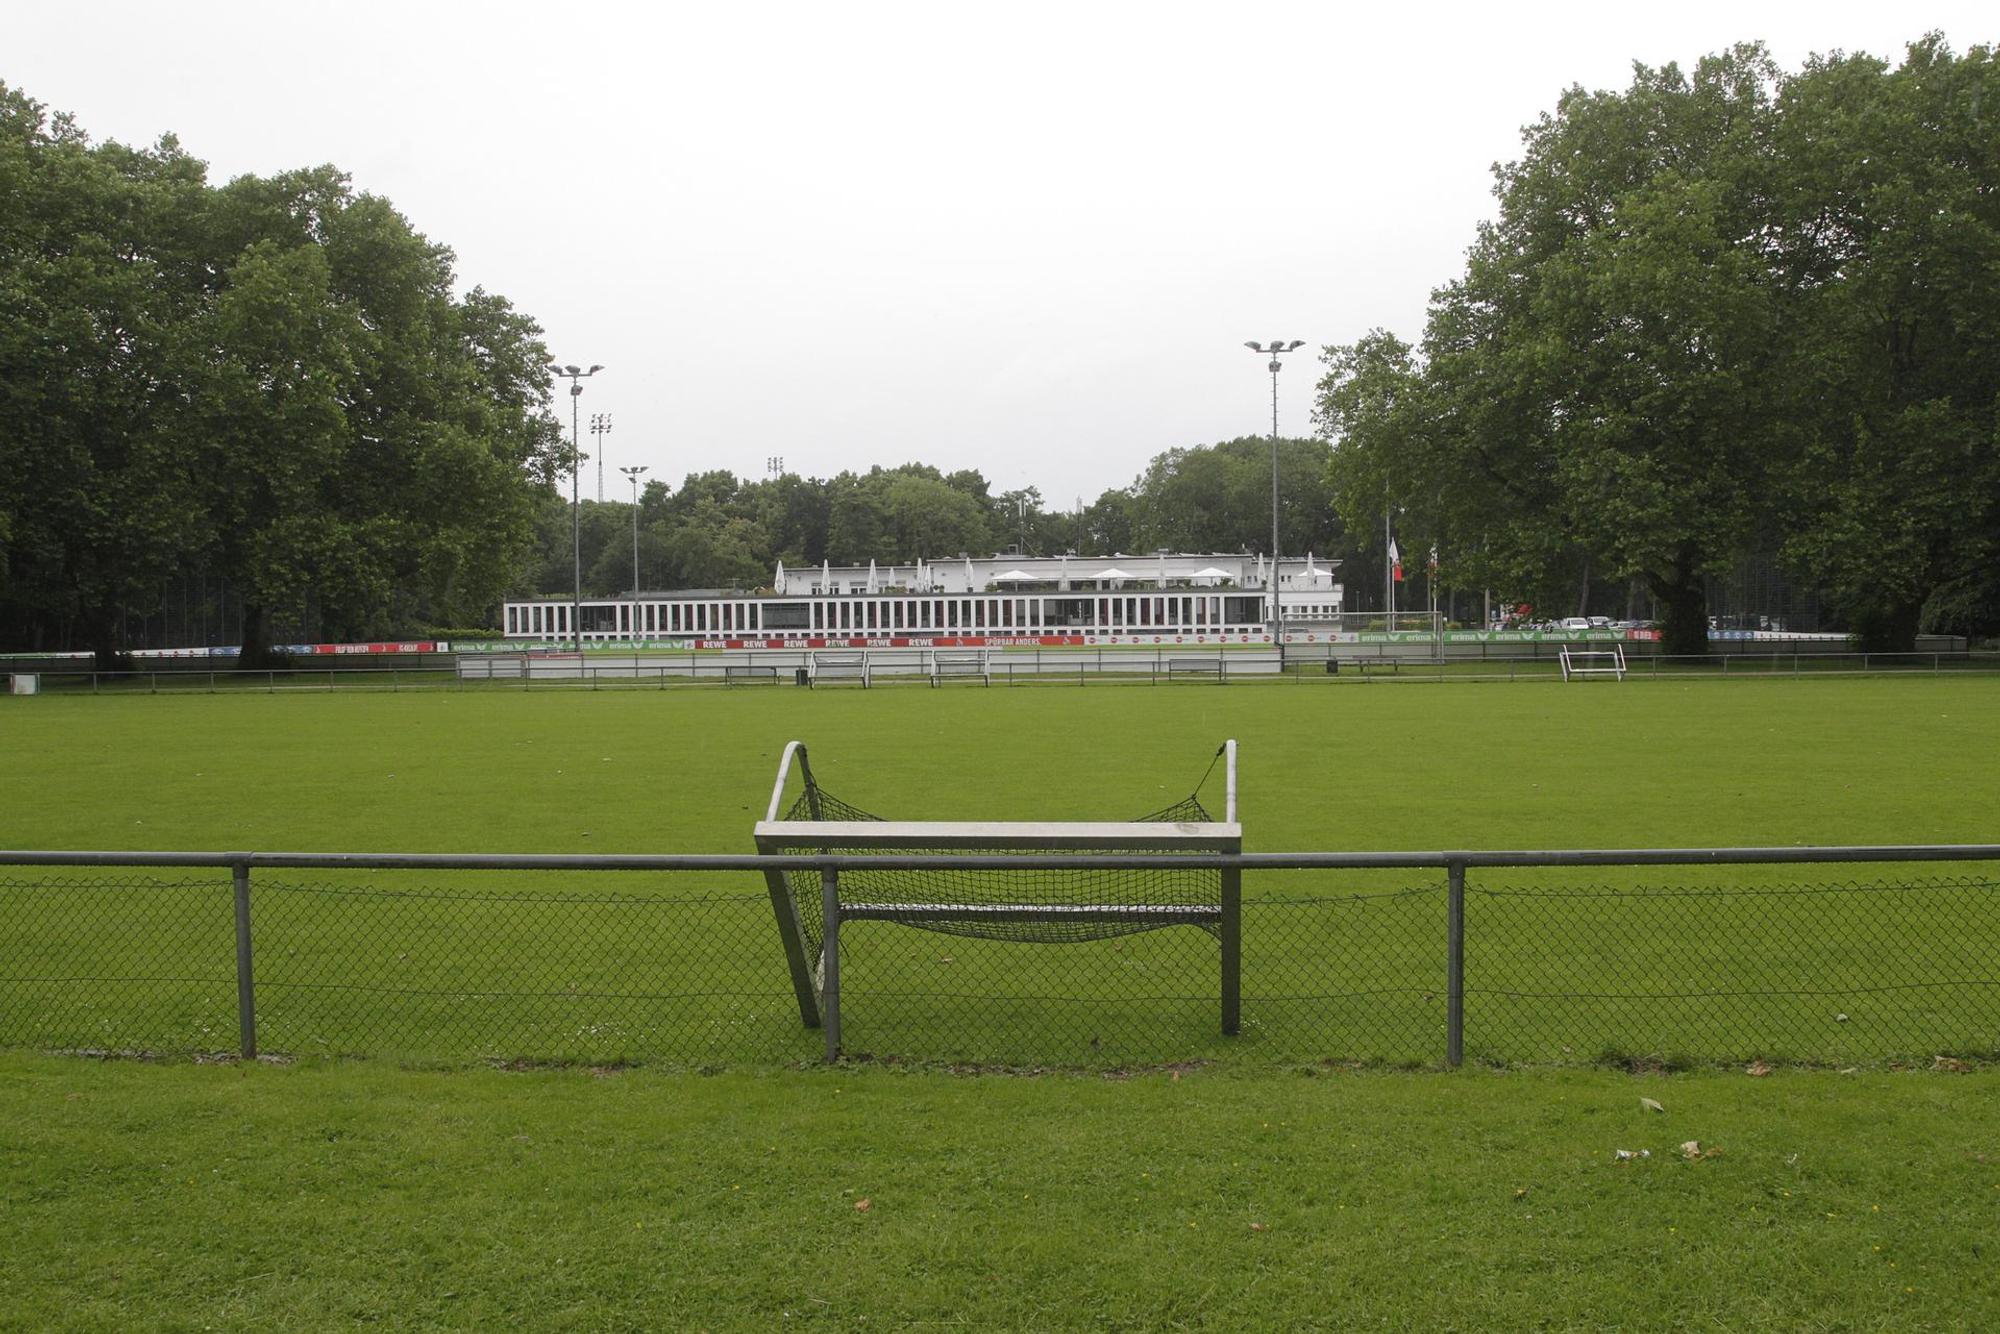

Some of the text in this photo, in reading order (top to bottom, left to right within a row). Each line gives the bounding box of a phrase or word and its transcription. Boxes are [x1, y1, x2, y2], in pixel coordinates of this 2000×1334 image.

[984, 637, 1041, 646] SPÜRBAR ANDERS
[1451, 633, 1476, 641] erima
[743, 640, 767, 648] REWE
[784, 640, 808, 648] REWE
[825, 639, 850, 647] REWE
[867, 639, 891, 647] REWE
